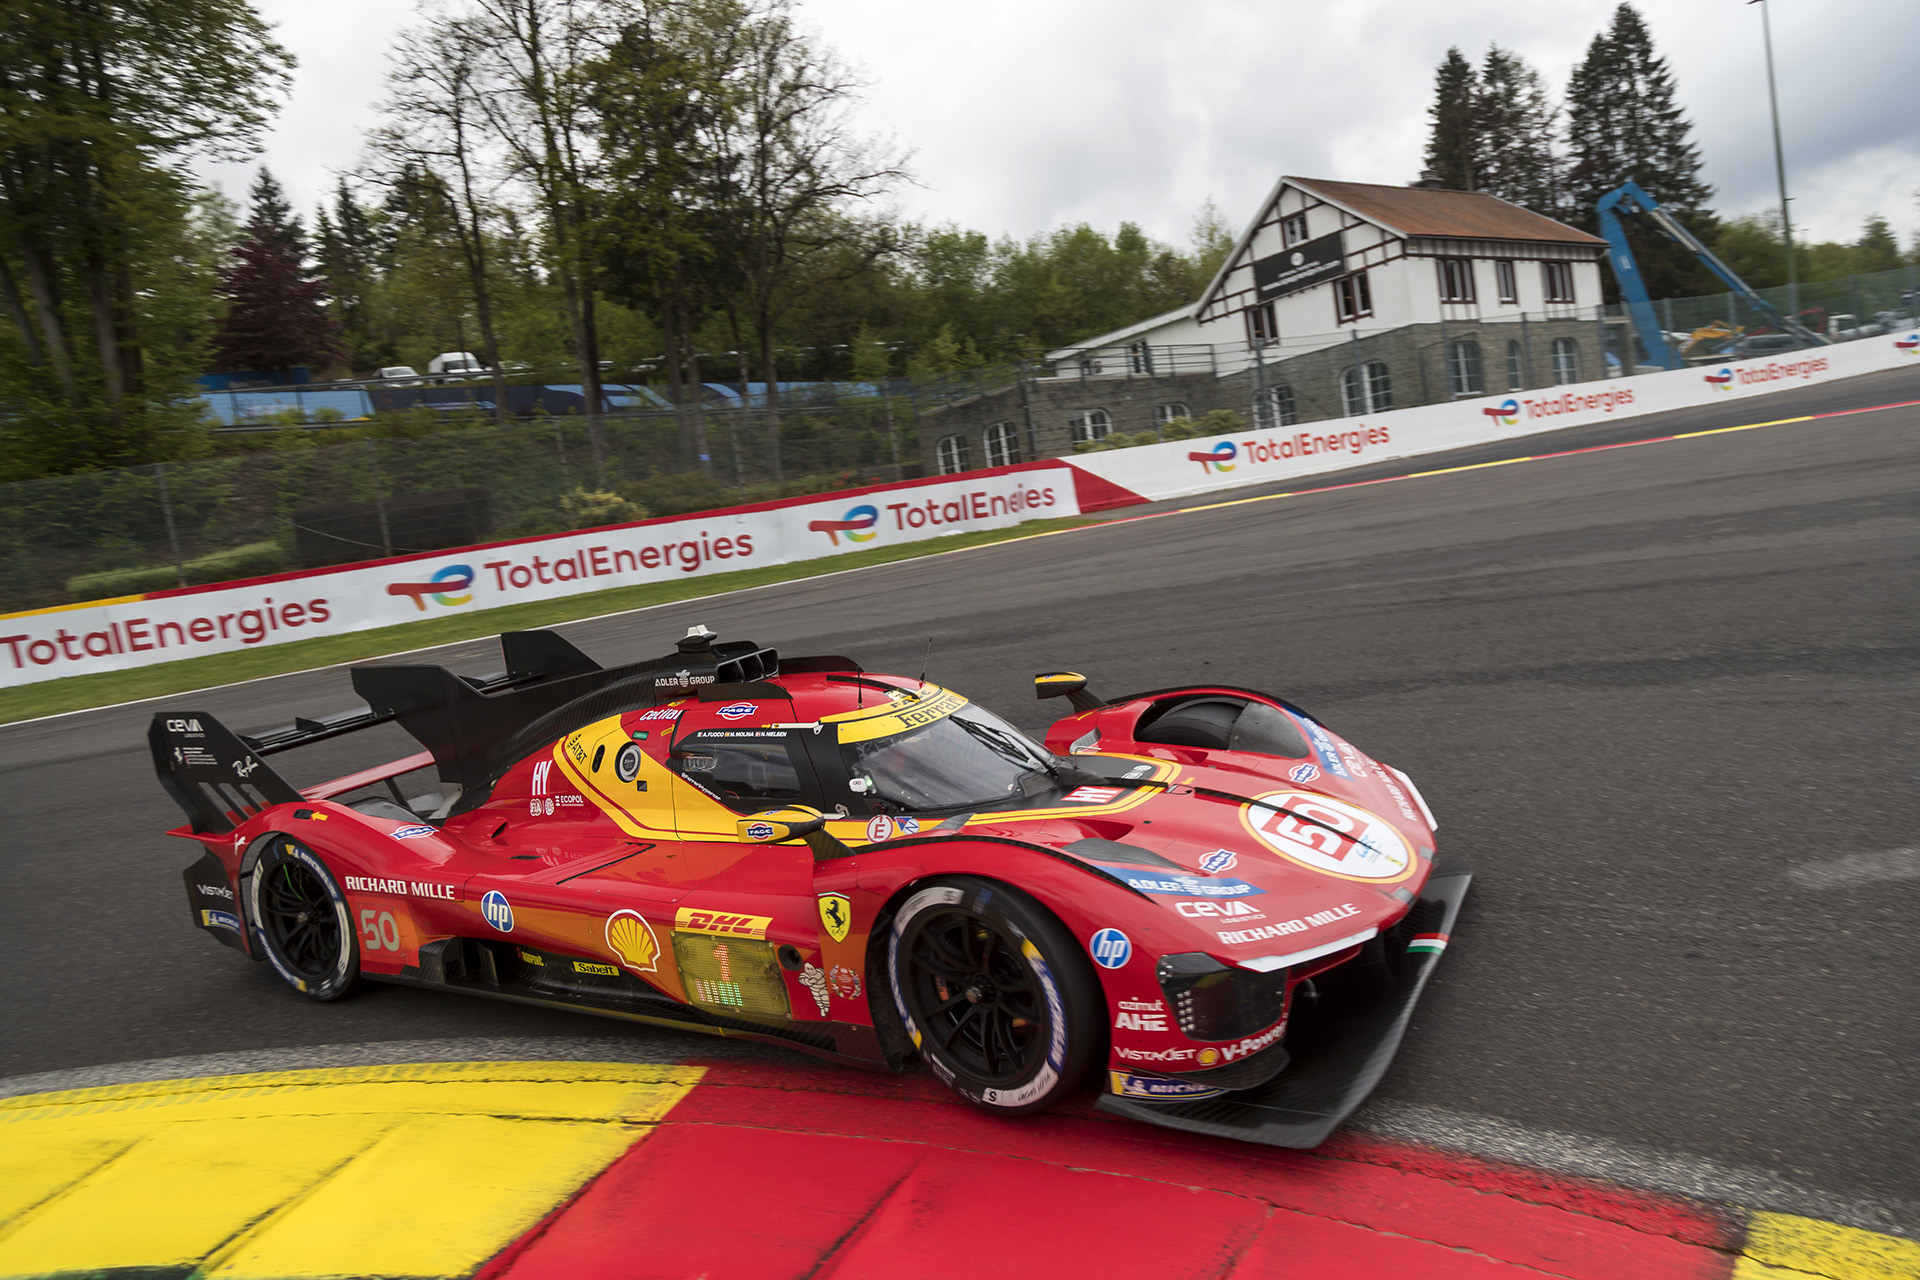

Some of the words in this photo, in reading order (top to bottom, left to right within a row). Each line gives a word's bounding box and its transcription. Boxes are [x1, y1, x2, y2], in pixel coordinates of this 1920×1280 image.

[1734, 356, 1829, 384] TotalEnergies
[1523, 386, 1634, 419] TotalEnergies
[1242, 424, 1390, 463] TotalEnergies
[484, 531, 754, 591] TotalEnergies
[0, 597, 330, 668] TotalEnergies
[655, 678, 679, 686] ADLER
[690, 676, 715, 685] GROUP
[890, 690, 931, 708] FAE
[894, 692, 967, 728] Ferrari
[571, 742, 588, 765] AT&T
[532, 760, 552, 796] HY
[560, 795, 584, 803] ECOPOL
[1064, 786, 1118, 803] HY
[873, 822, 886, 839] E
[1276, 802, 1354, 854] 50
[345, 876, 408, 895] RICHARD
[411, 881, 455, 900] MILLE
[1128, 878, 1185, 892] ADLER
[488, 891, 509, 931] hp
[687, 912, 754, 934] DHL
[1216, 919, 1309, 944] RICHARD
[1304, 903, 1362, 927] MILLE
[360, 909, 400, 952] 50
[1096, 929, 1126, 967] hp
[577, 963, 615, 975] Sabelt
[1117, 996, 1164, 1011] azimut
[1114, 1012, 1169, 1031] AHE
[1221, 1021, 1287, 1060] V-Power
[988, 1090, 998, 1102] S
